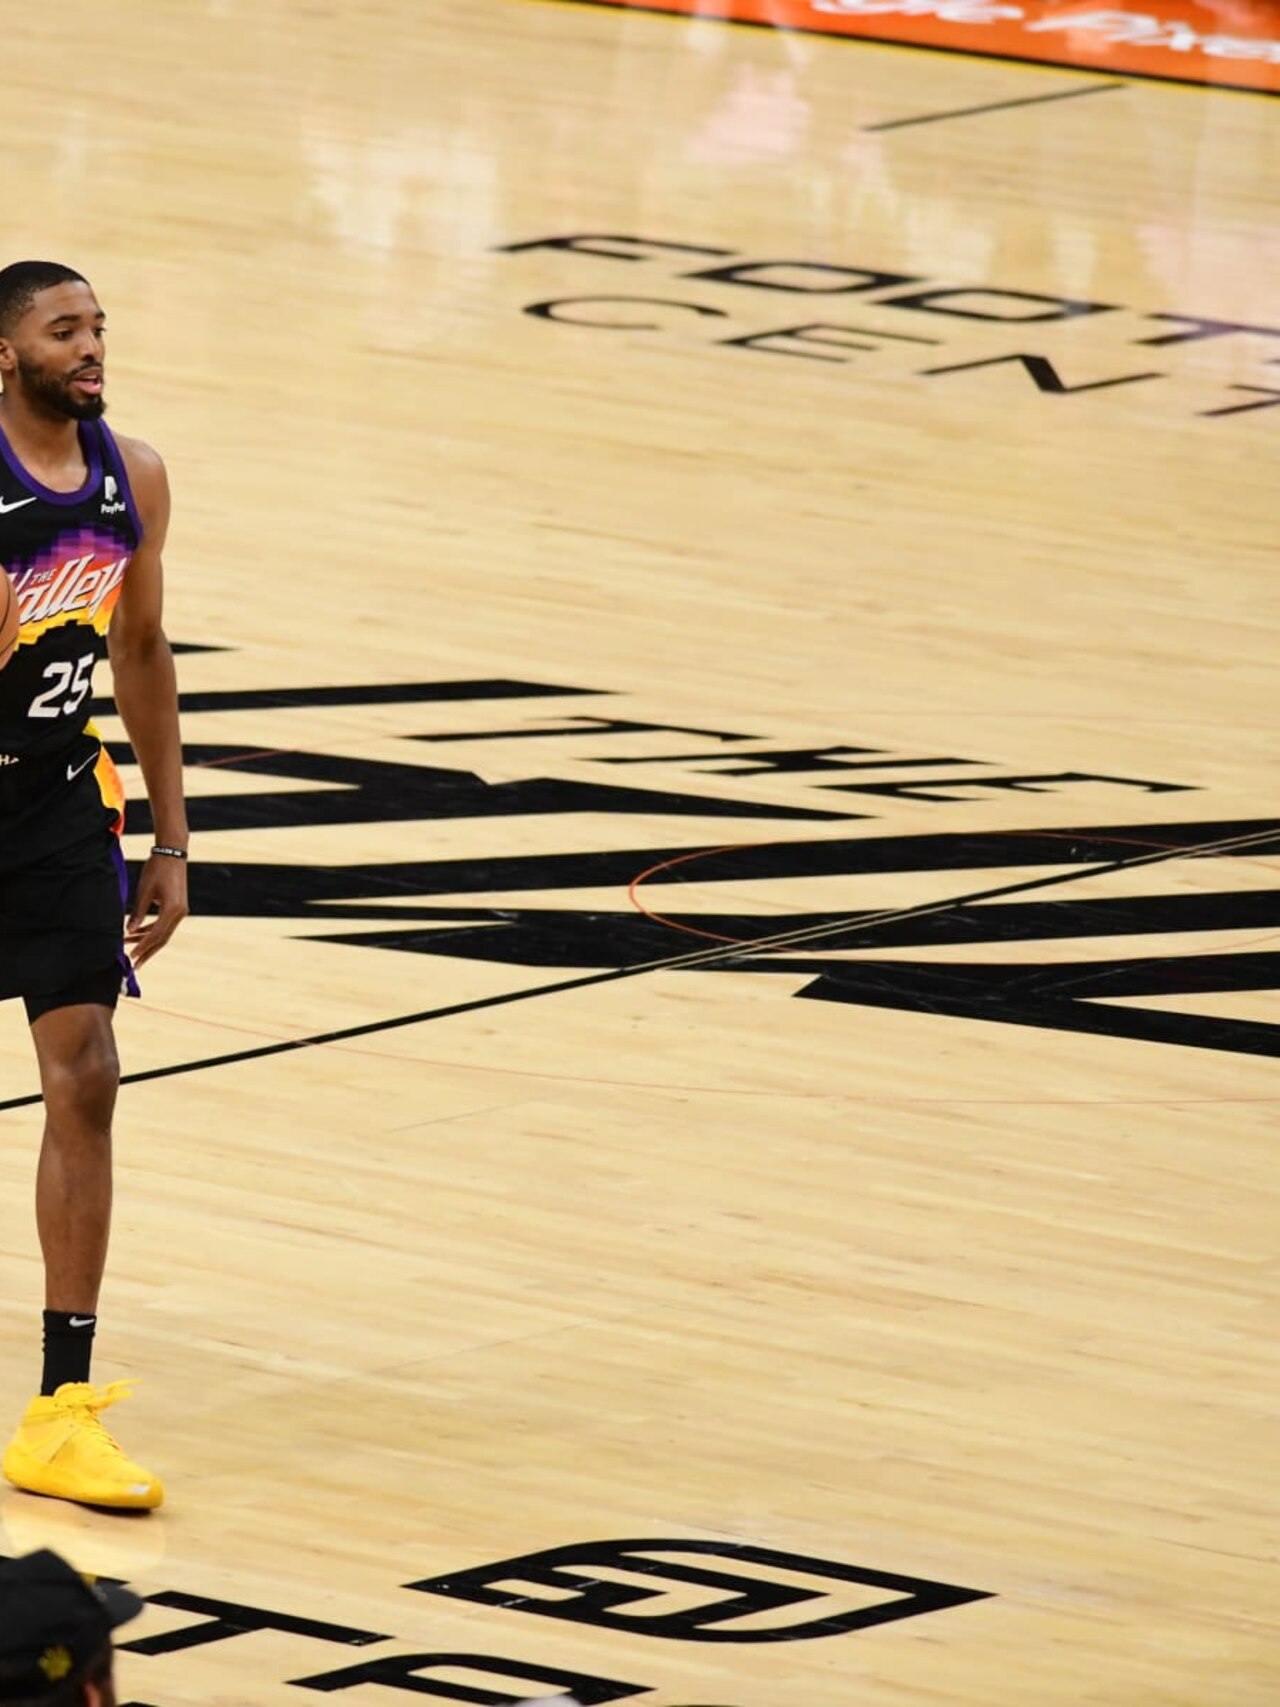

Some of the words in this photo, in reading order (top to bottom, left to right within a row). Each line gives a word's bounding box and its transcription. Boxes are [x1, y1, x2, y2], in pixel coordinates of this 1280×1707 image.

[490, 232, 1280, 366] FOOT
[100, 501, 126, 515] PayPal
[31, 568, 57, 587] THE
[28, 652, 94, 717] 25
[394, 714, 1212, 802] THE
